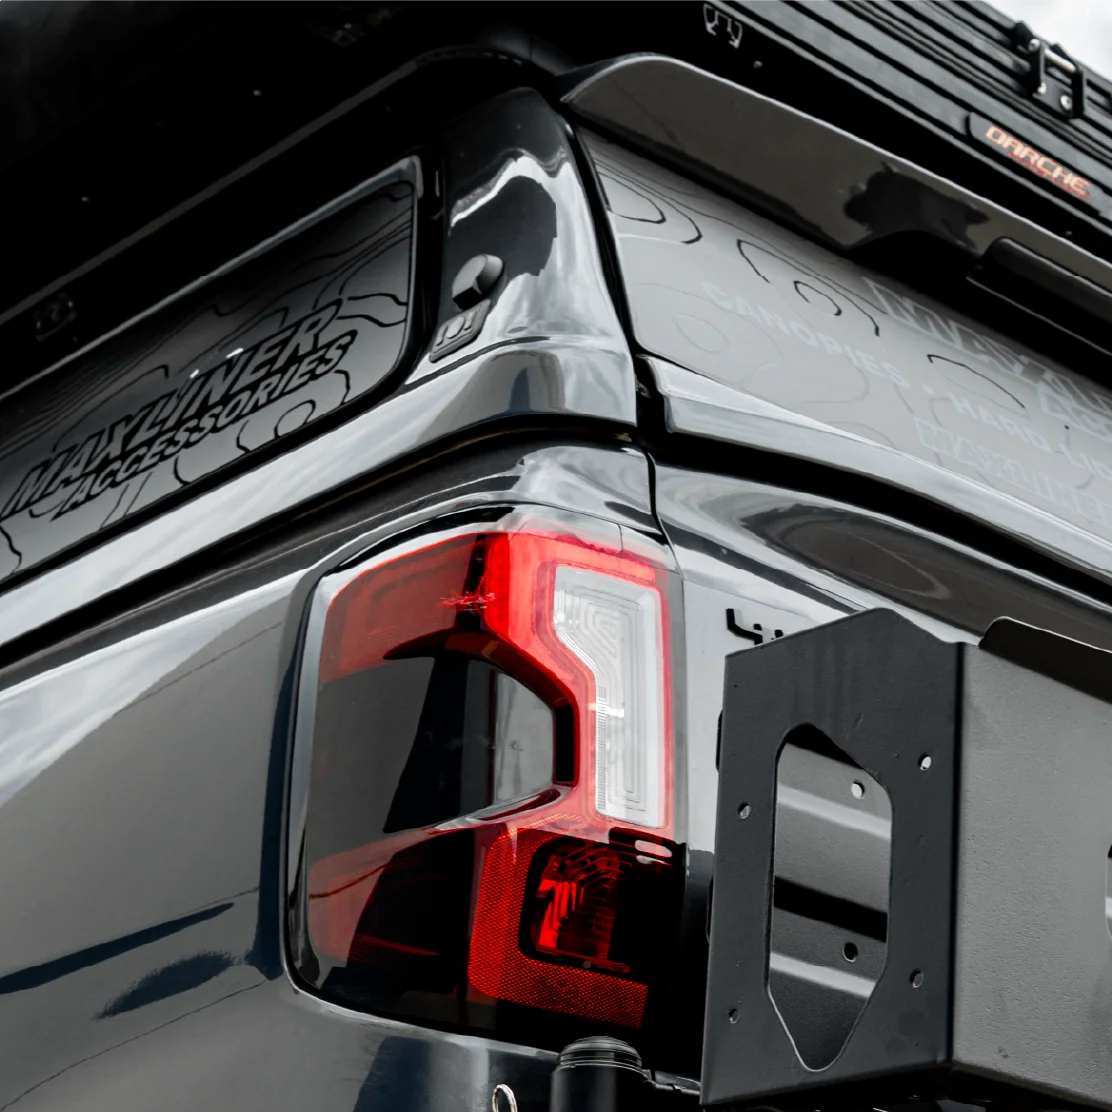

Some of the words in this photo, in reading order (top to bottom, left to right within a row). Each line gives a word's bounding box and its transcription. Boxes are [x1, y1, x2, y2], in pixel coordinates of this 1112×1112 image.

[986, 126, 1091, 196] DARCHE
[701, 281, 910, 389] CANOPIES
[1, 299, 343, 519] MAXLINER
[50, 329, 358, 522] ACCESSORIES
[948, 392, 1051, 453] HARD
